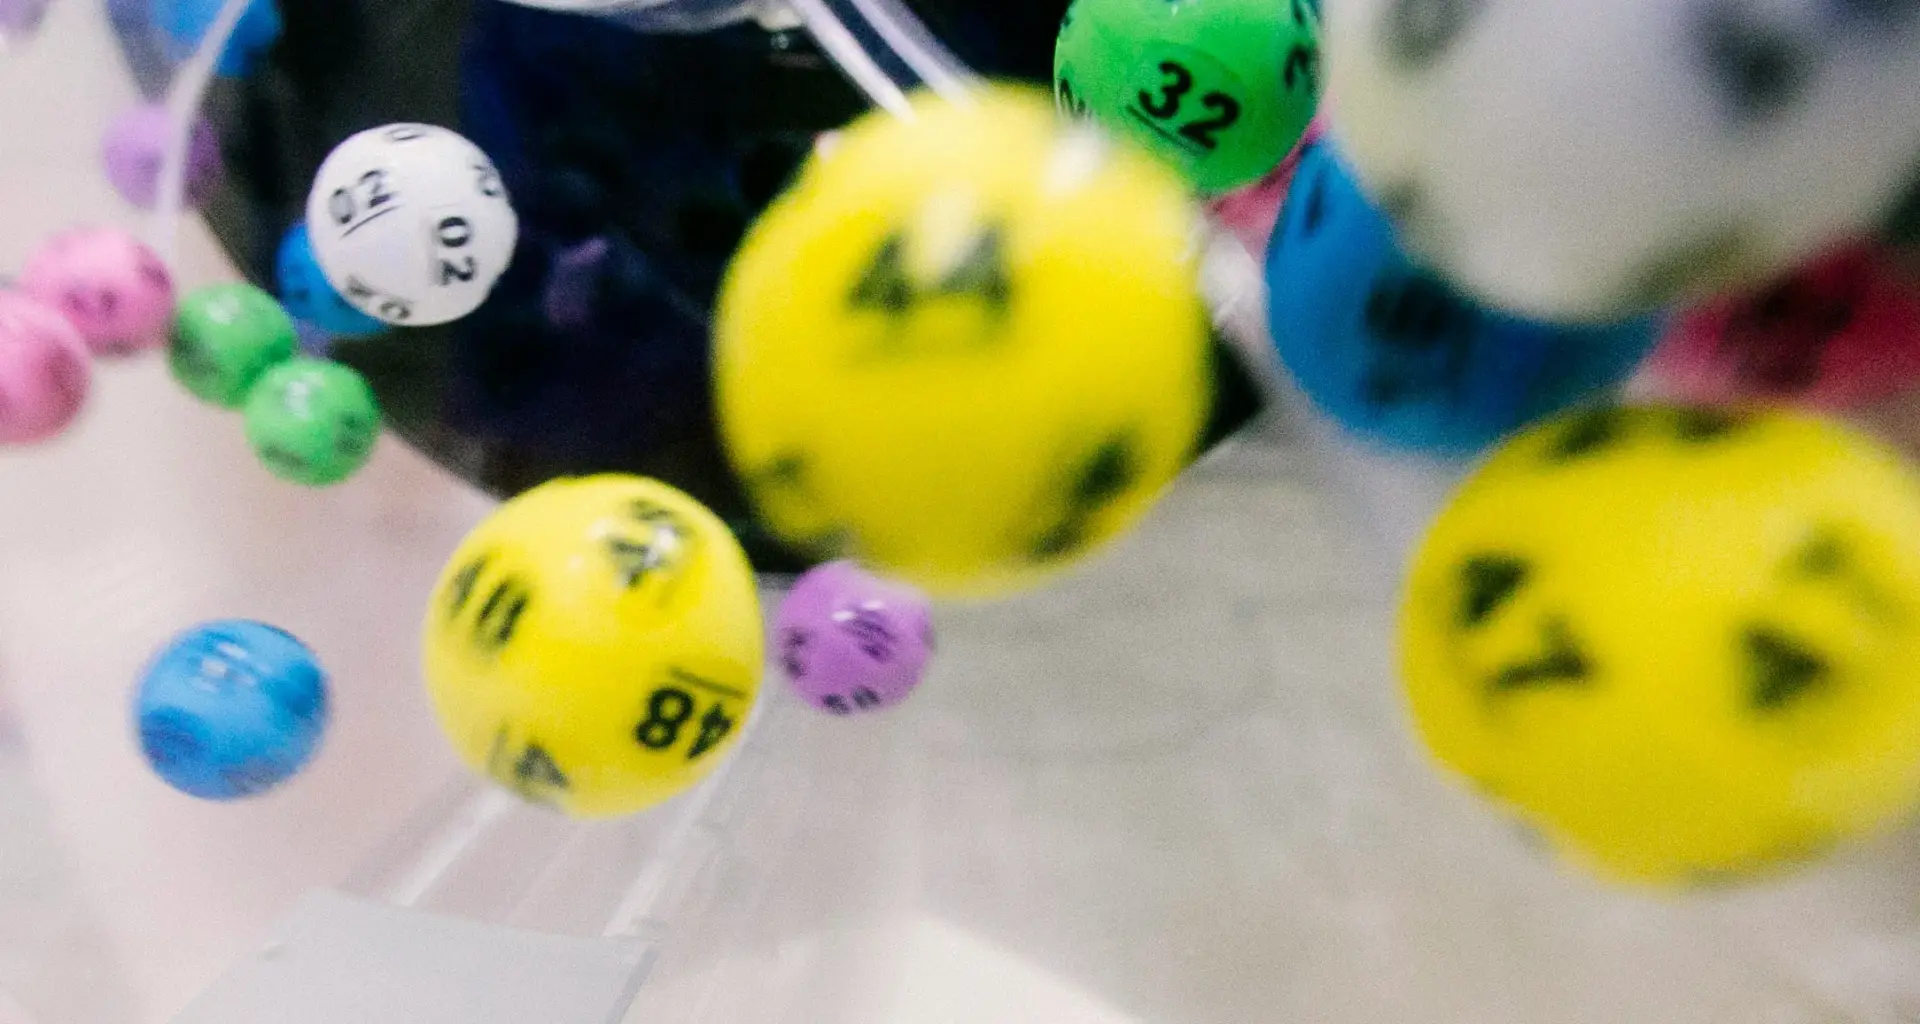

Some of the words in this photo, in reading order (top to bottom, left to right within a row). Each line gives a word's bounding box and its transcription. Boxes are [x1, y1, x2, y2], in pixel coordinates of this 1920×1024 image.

[1137, 60, 1241, 150] 32
[328, 168, 396, 226] 02
[436, 216, 476, 286] 02
[634, 686, 735, 761] 48
